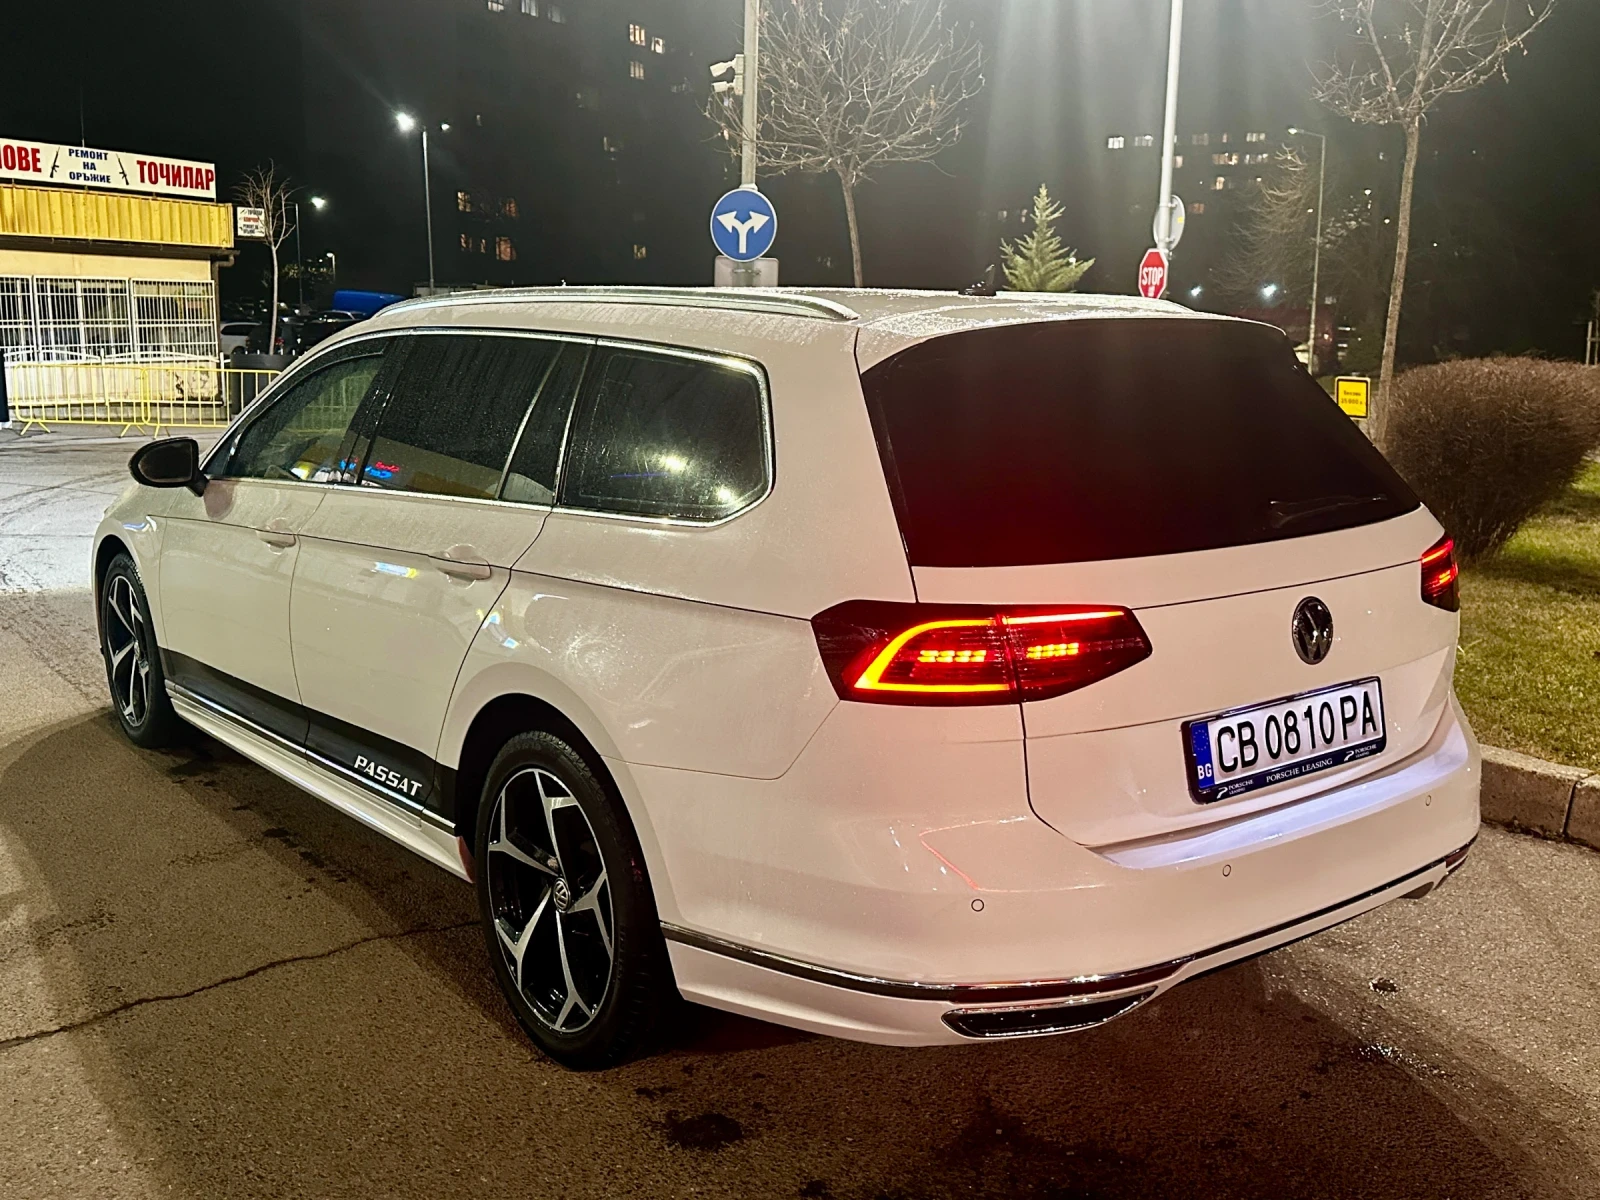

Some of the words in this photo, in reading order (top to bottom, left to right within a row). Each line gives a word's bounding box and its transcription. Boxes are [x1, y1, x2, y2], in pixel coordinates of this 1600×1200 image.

[0, 144, 42, 173] ОВЕ
[69, 148, 109, 161] РЕМОНТ
[82, 161, 97, 171] НА
[69, 171, 111, 184] ОРЪЖИЕ
[136, 160, 215, 191] ТОЧИЛАР
[1142, 266, 1164, 286] STOP
[1217, 720, 1259, 773] CB
[1265, 701, 1335, 760] 0810
[1339, 690, 1377, 741] PA
[1354, 743, 1377, 755] PORSCHE
[353, 754, 423, 797] PASSAT
[1197, 763, 1212, 780] BG
[1266, 767, 1300, 783] PORSCHE
[1301, 757, 1334, 772] LEASING
[1228, 778, 1255, 790] PORSCHE
